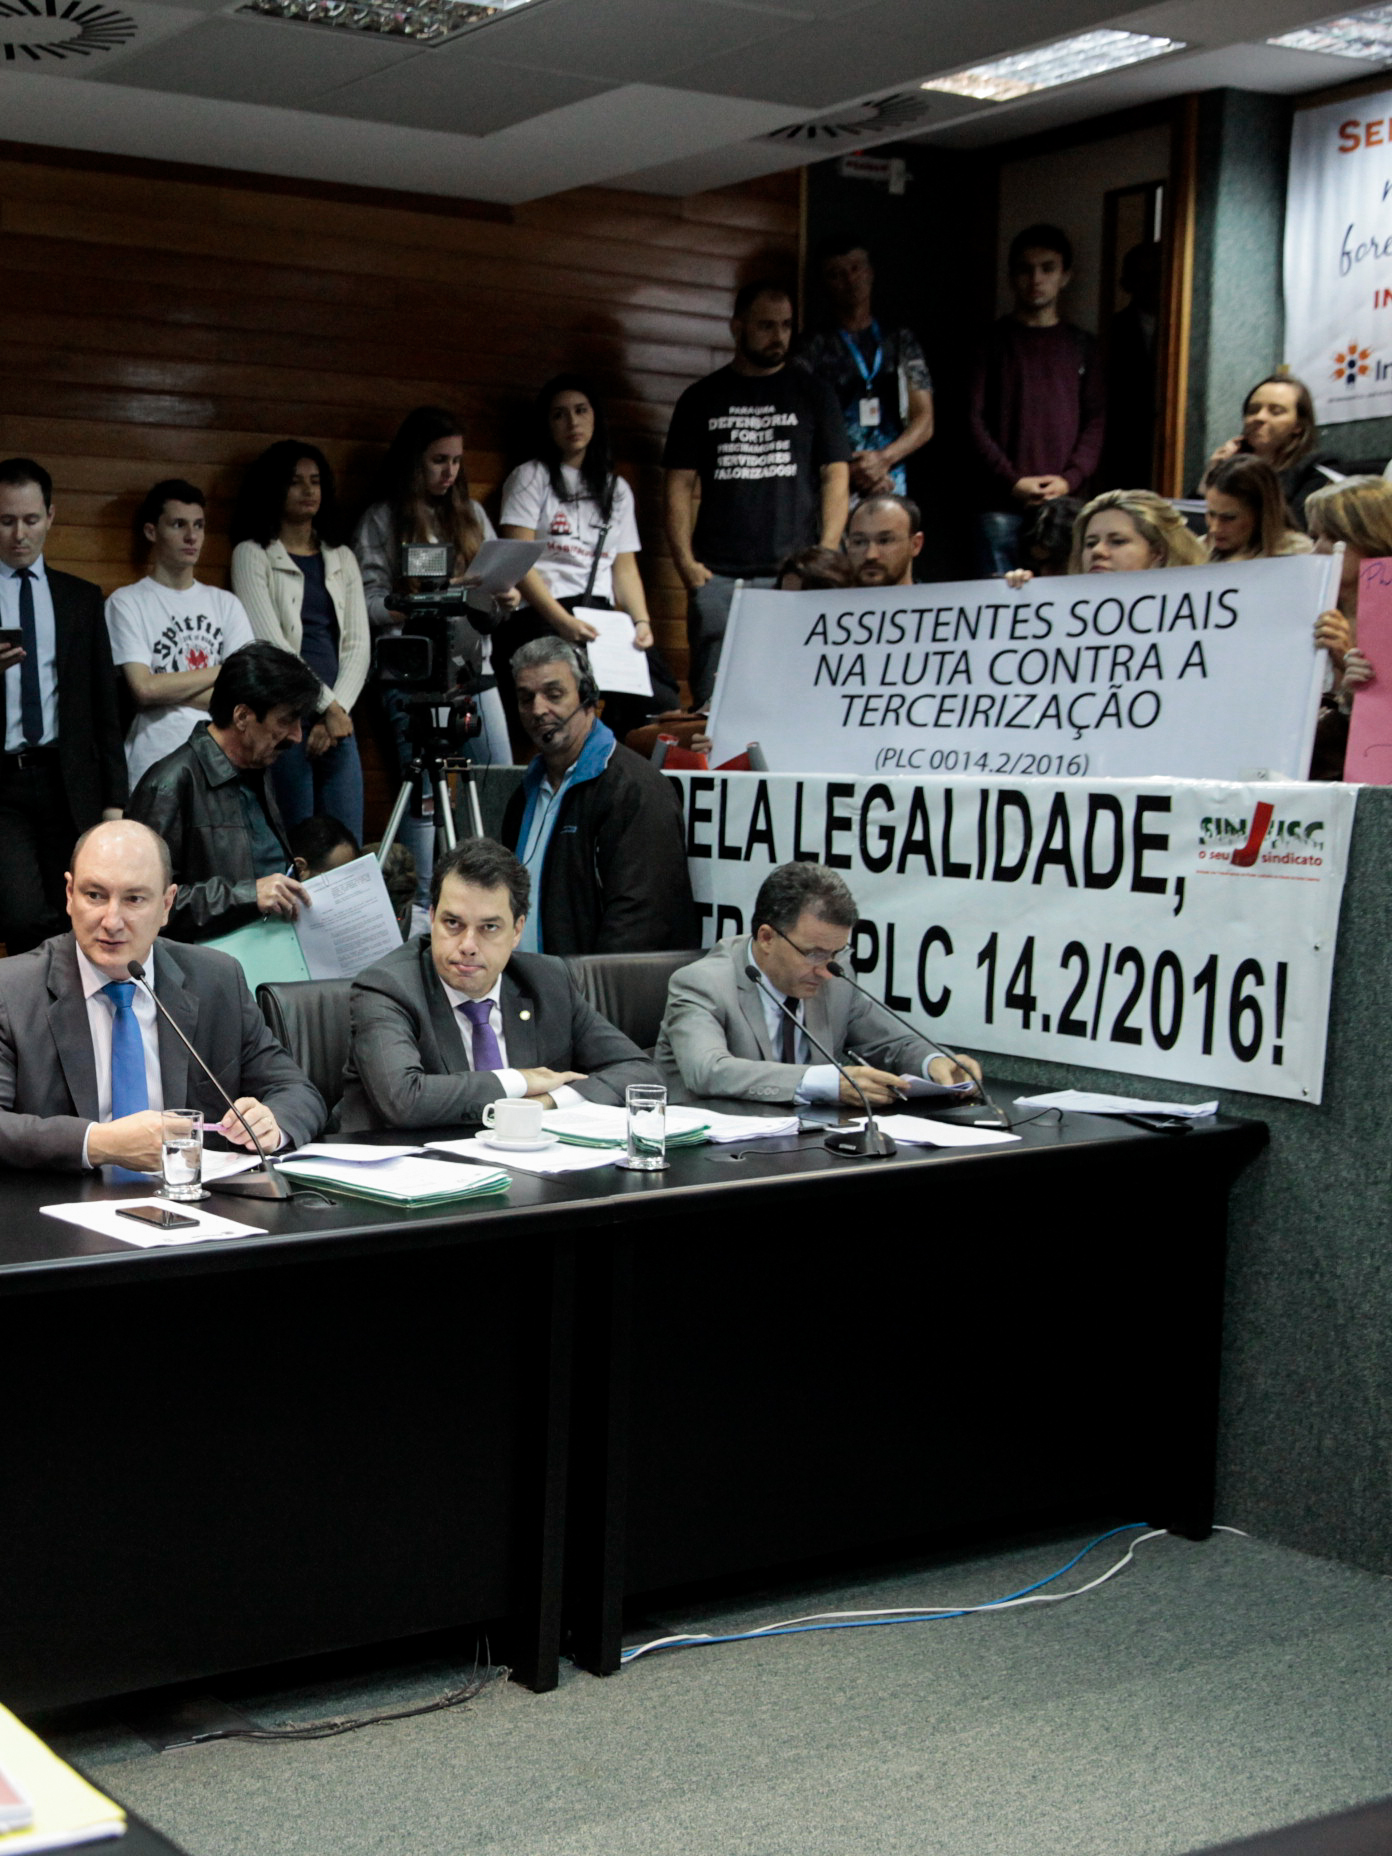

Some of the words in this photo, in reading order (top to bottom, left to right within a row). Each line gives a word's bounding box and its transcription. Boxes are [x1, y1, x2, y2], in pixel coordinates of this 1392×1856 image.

[803, 602, 1055, 646] ASSISTENTES
[1066, 588, 1240, 637] SOCIAIS
[814, 653, 866, 687] NA
[879, 650, 973, 687] LUTA
[989, 642, 1164, 686] CONTRA
[1177, 640, 1208, 680] A
[841, 684, 1161, 740] TERCEIRIZAÇÃO
[875, 748, 926, 771] (PLC
[929, 749, 1090, 777] 0014.2/2016)
[793, 781, 1186, 917] LEGALIDADE,
[1198, 851, 1206, 860] o
[1209, 850, 1230, 861] seu
[1262, 851, 1323, 867] sindicato
[850, 918, 954, 1019] PLC
[976, 931, 1288, 1066] 14.2/2016!
